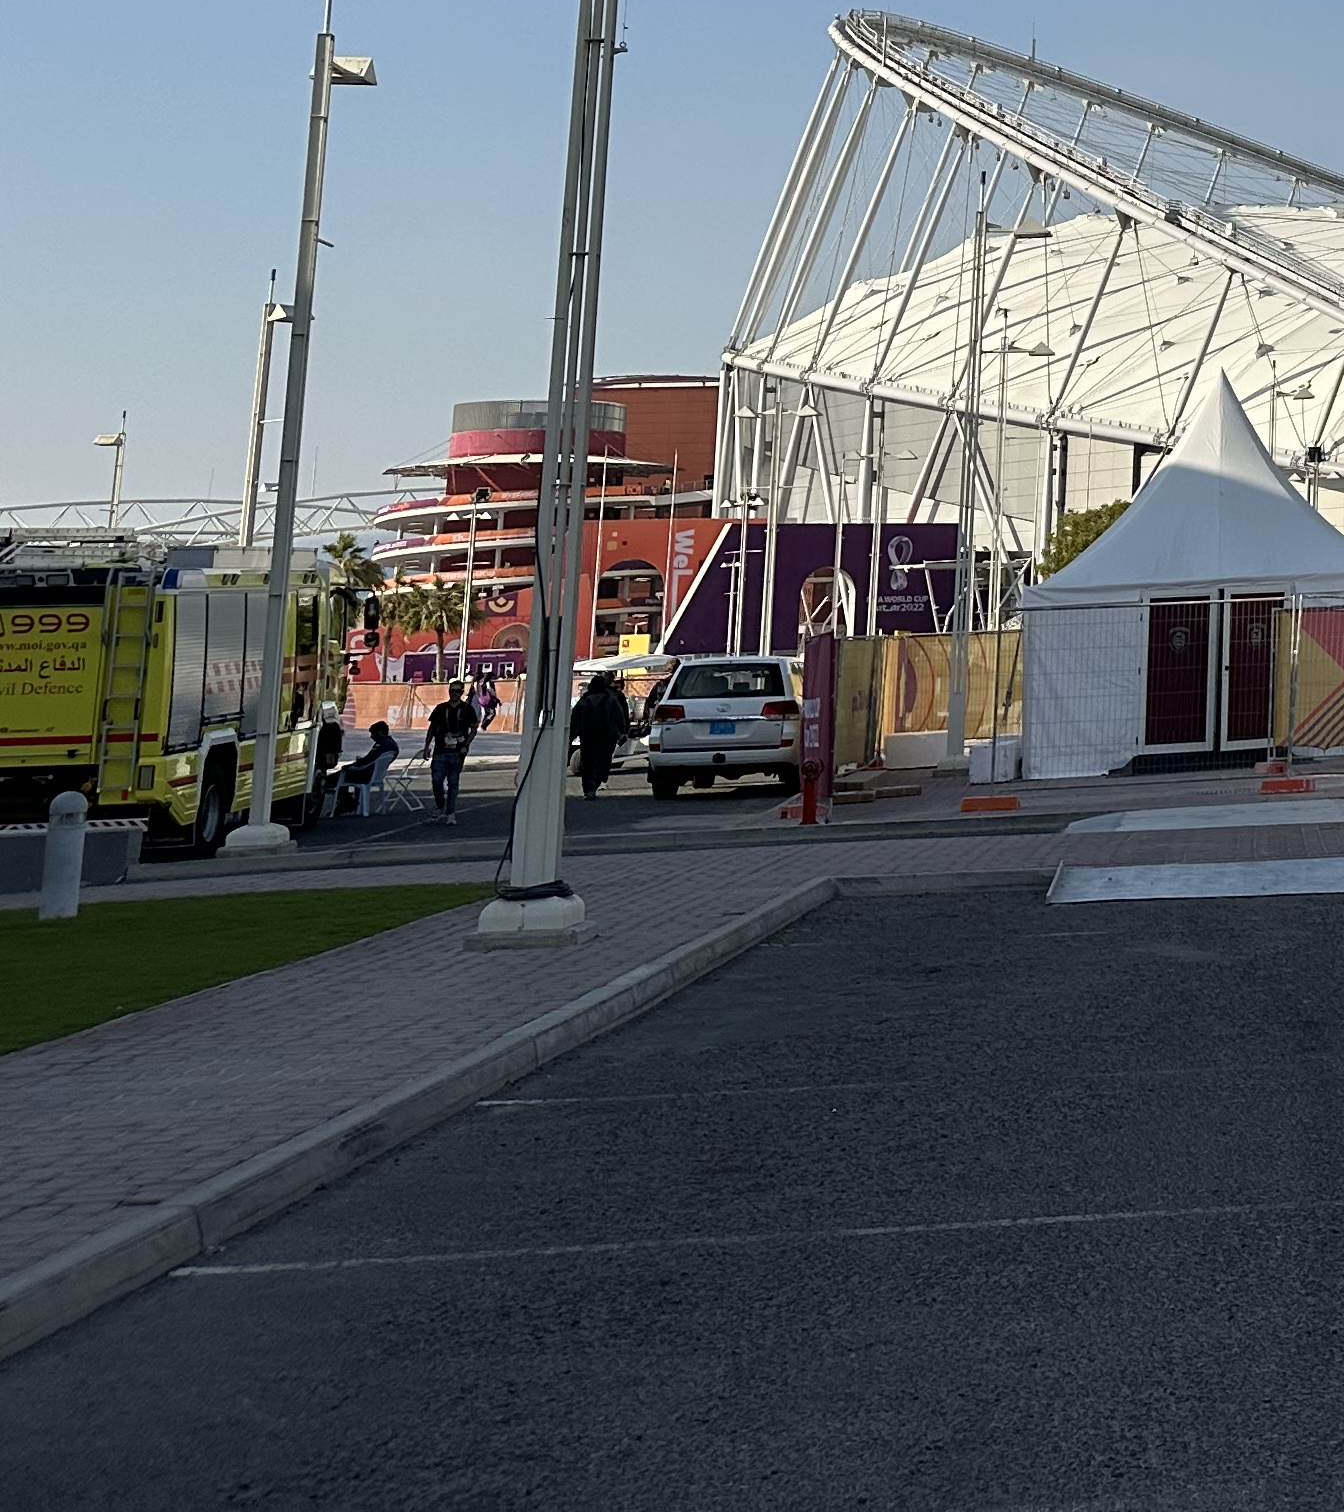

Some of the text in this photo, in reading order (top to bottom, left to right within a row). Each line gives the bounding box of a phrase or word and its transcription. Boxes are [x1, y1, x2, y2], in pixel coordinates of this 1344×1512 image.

[884, 595, 913, 603] WORLD
[914, 595, 929, 603] CUP
[11, 613, 90, 634] 999
[38, 655, 86, 679] الدفاع
[21, 681, 84, 696] Defence
